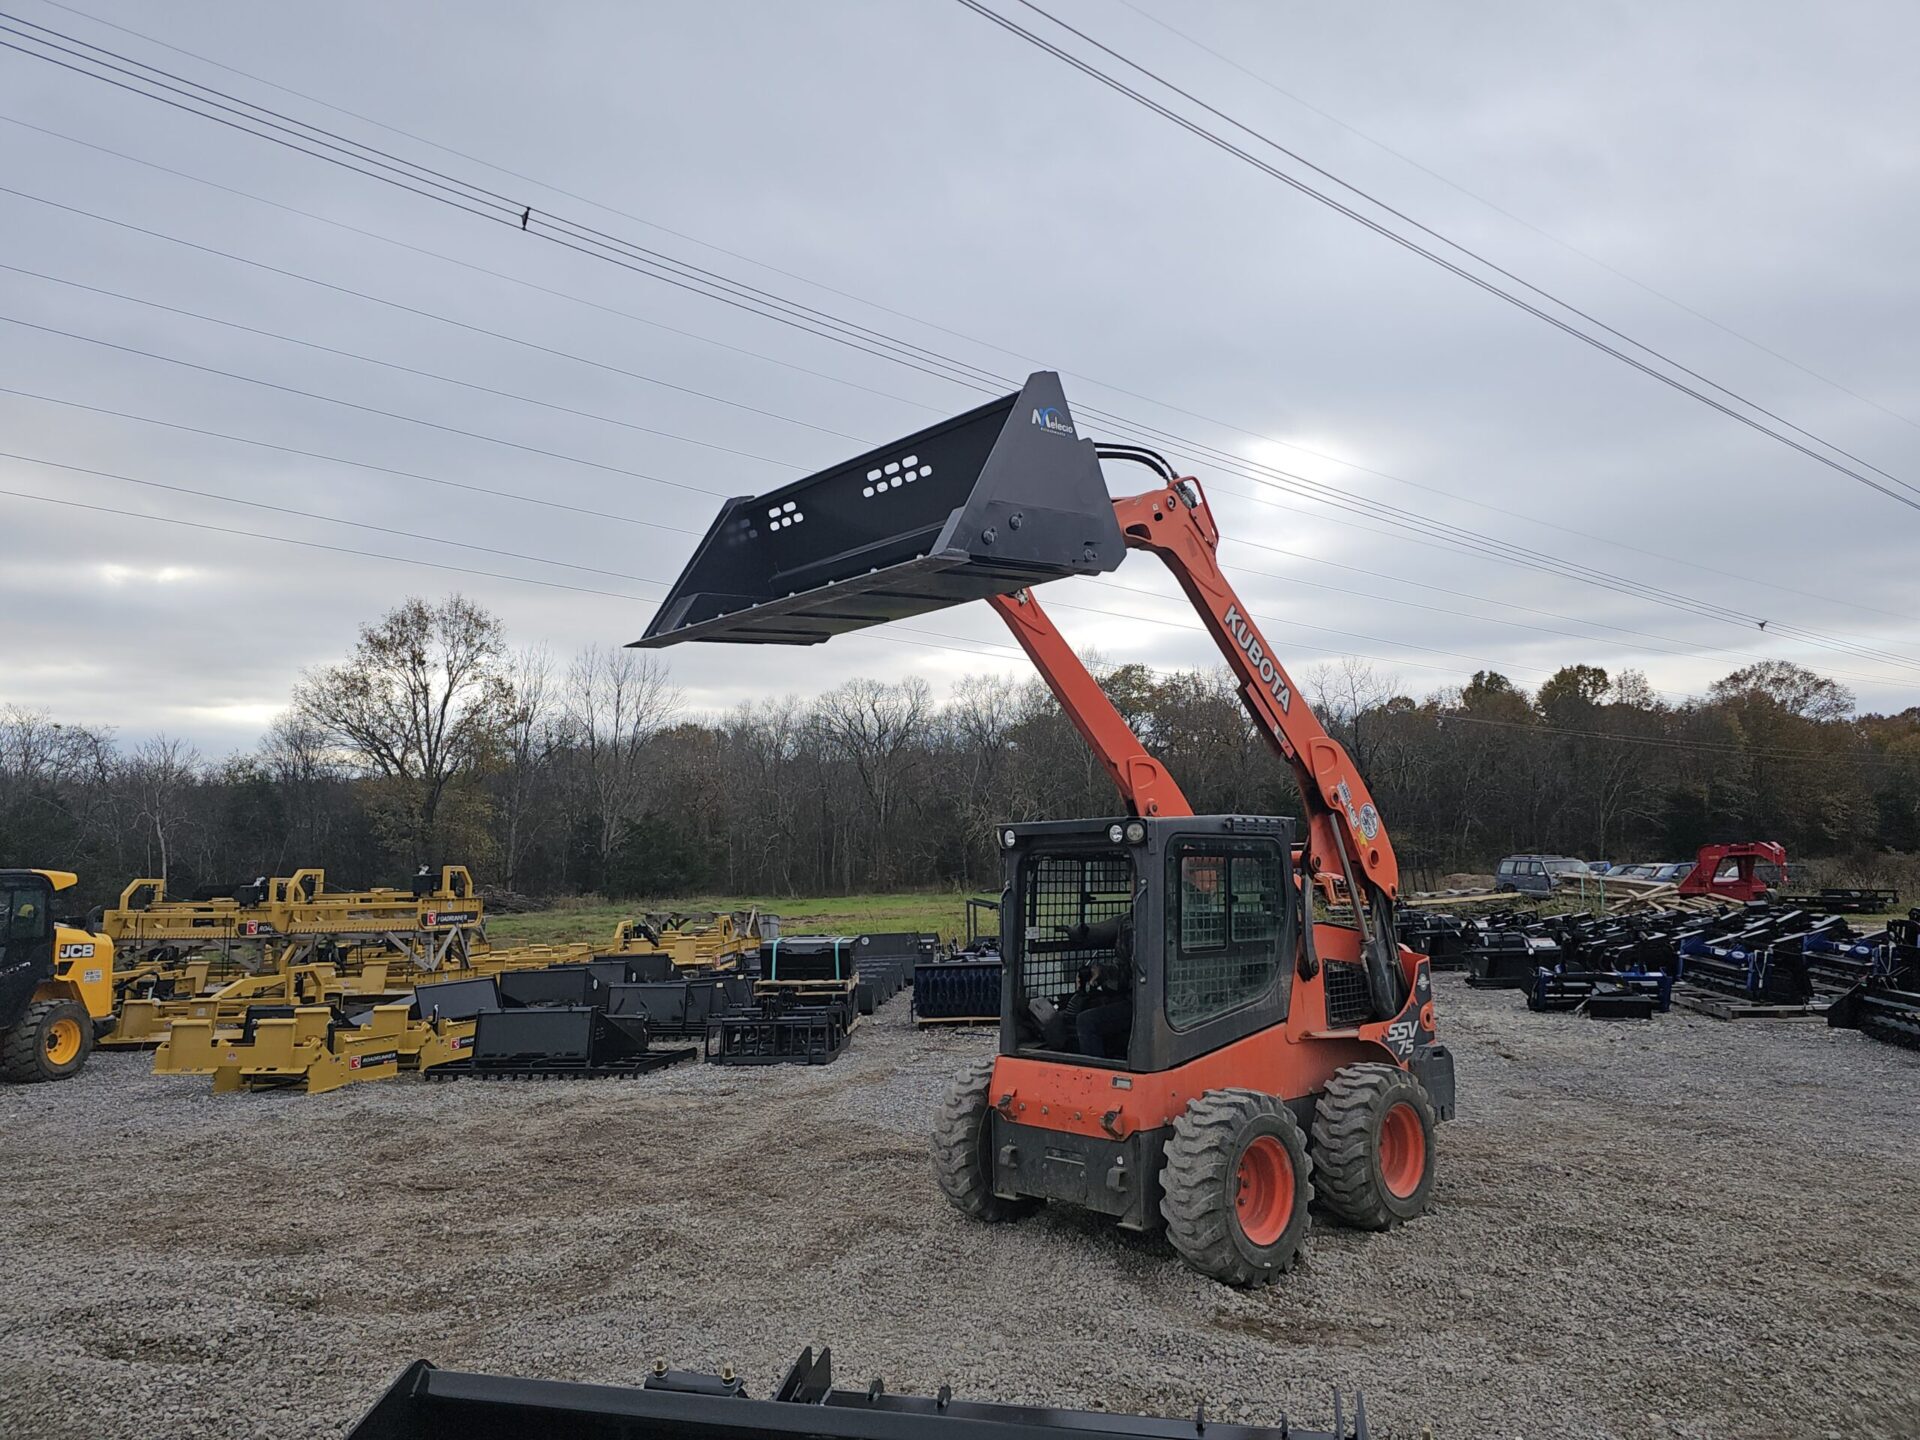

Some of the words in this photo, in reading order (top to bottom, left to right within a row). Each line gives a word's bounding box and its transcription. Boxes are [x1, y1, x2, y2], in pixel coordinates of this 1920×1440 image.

[1031, 408, 1073, 434] Melecio
[1224, 604, 1291, 713] KUBOTA
[60, 944, 94, 958] JCB
[1387, 1020, 1419, 1042] SSV
[1398, 1039, 1414, 1055] 75
